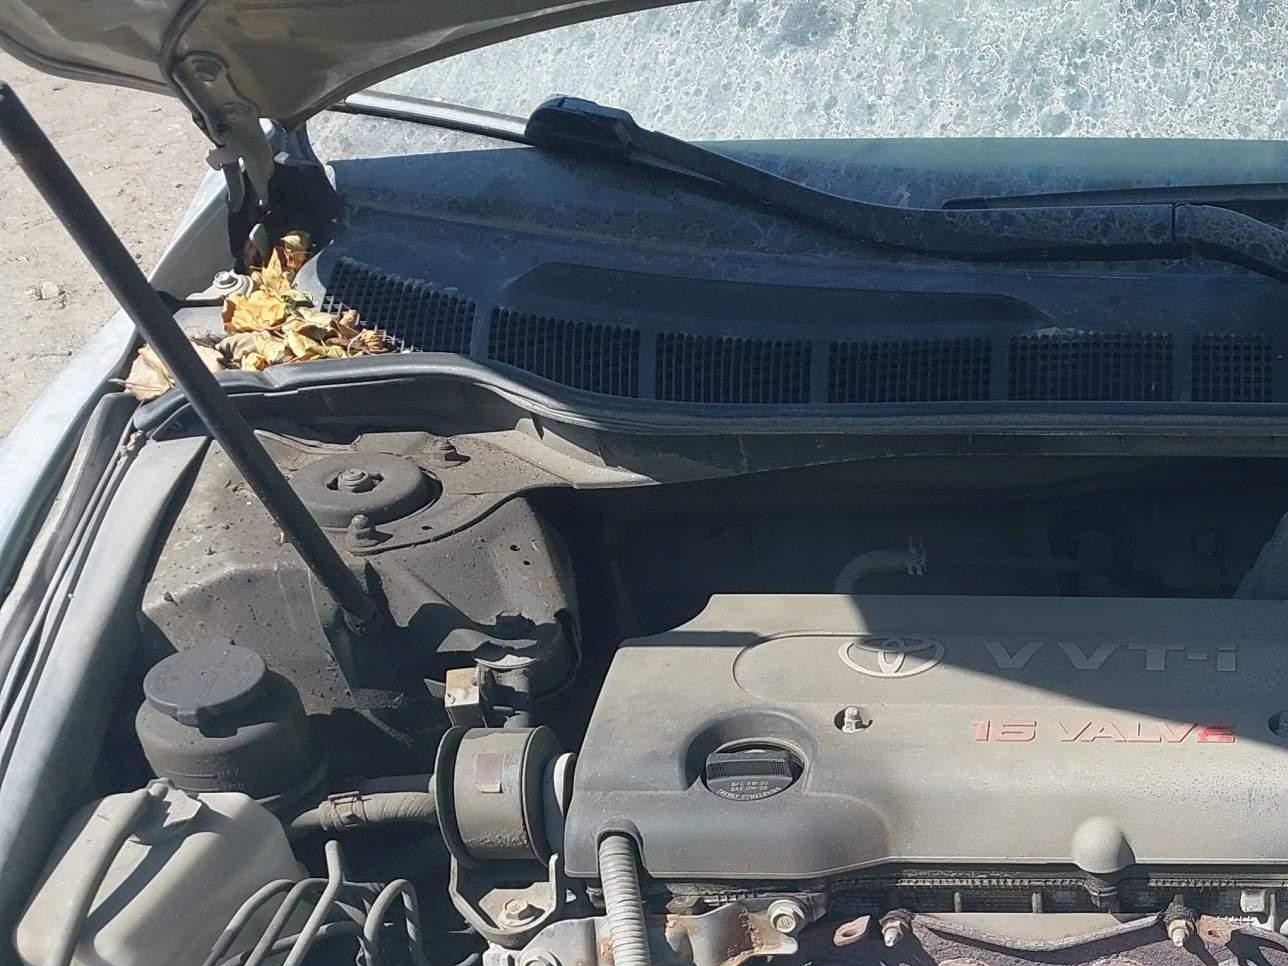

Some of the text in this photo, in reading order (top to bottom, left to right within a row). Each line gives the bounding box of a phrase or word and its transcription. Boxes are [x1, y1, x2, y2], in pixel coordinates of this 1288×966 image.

[982, 640, 1238, 673] VVT-i
[972, 719, 1236, 744] 16 VALVE
